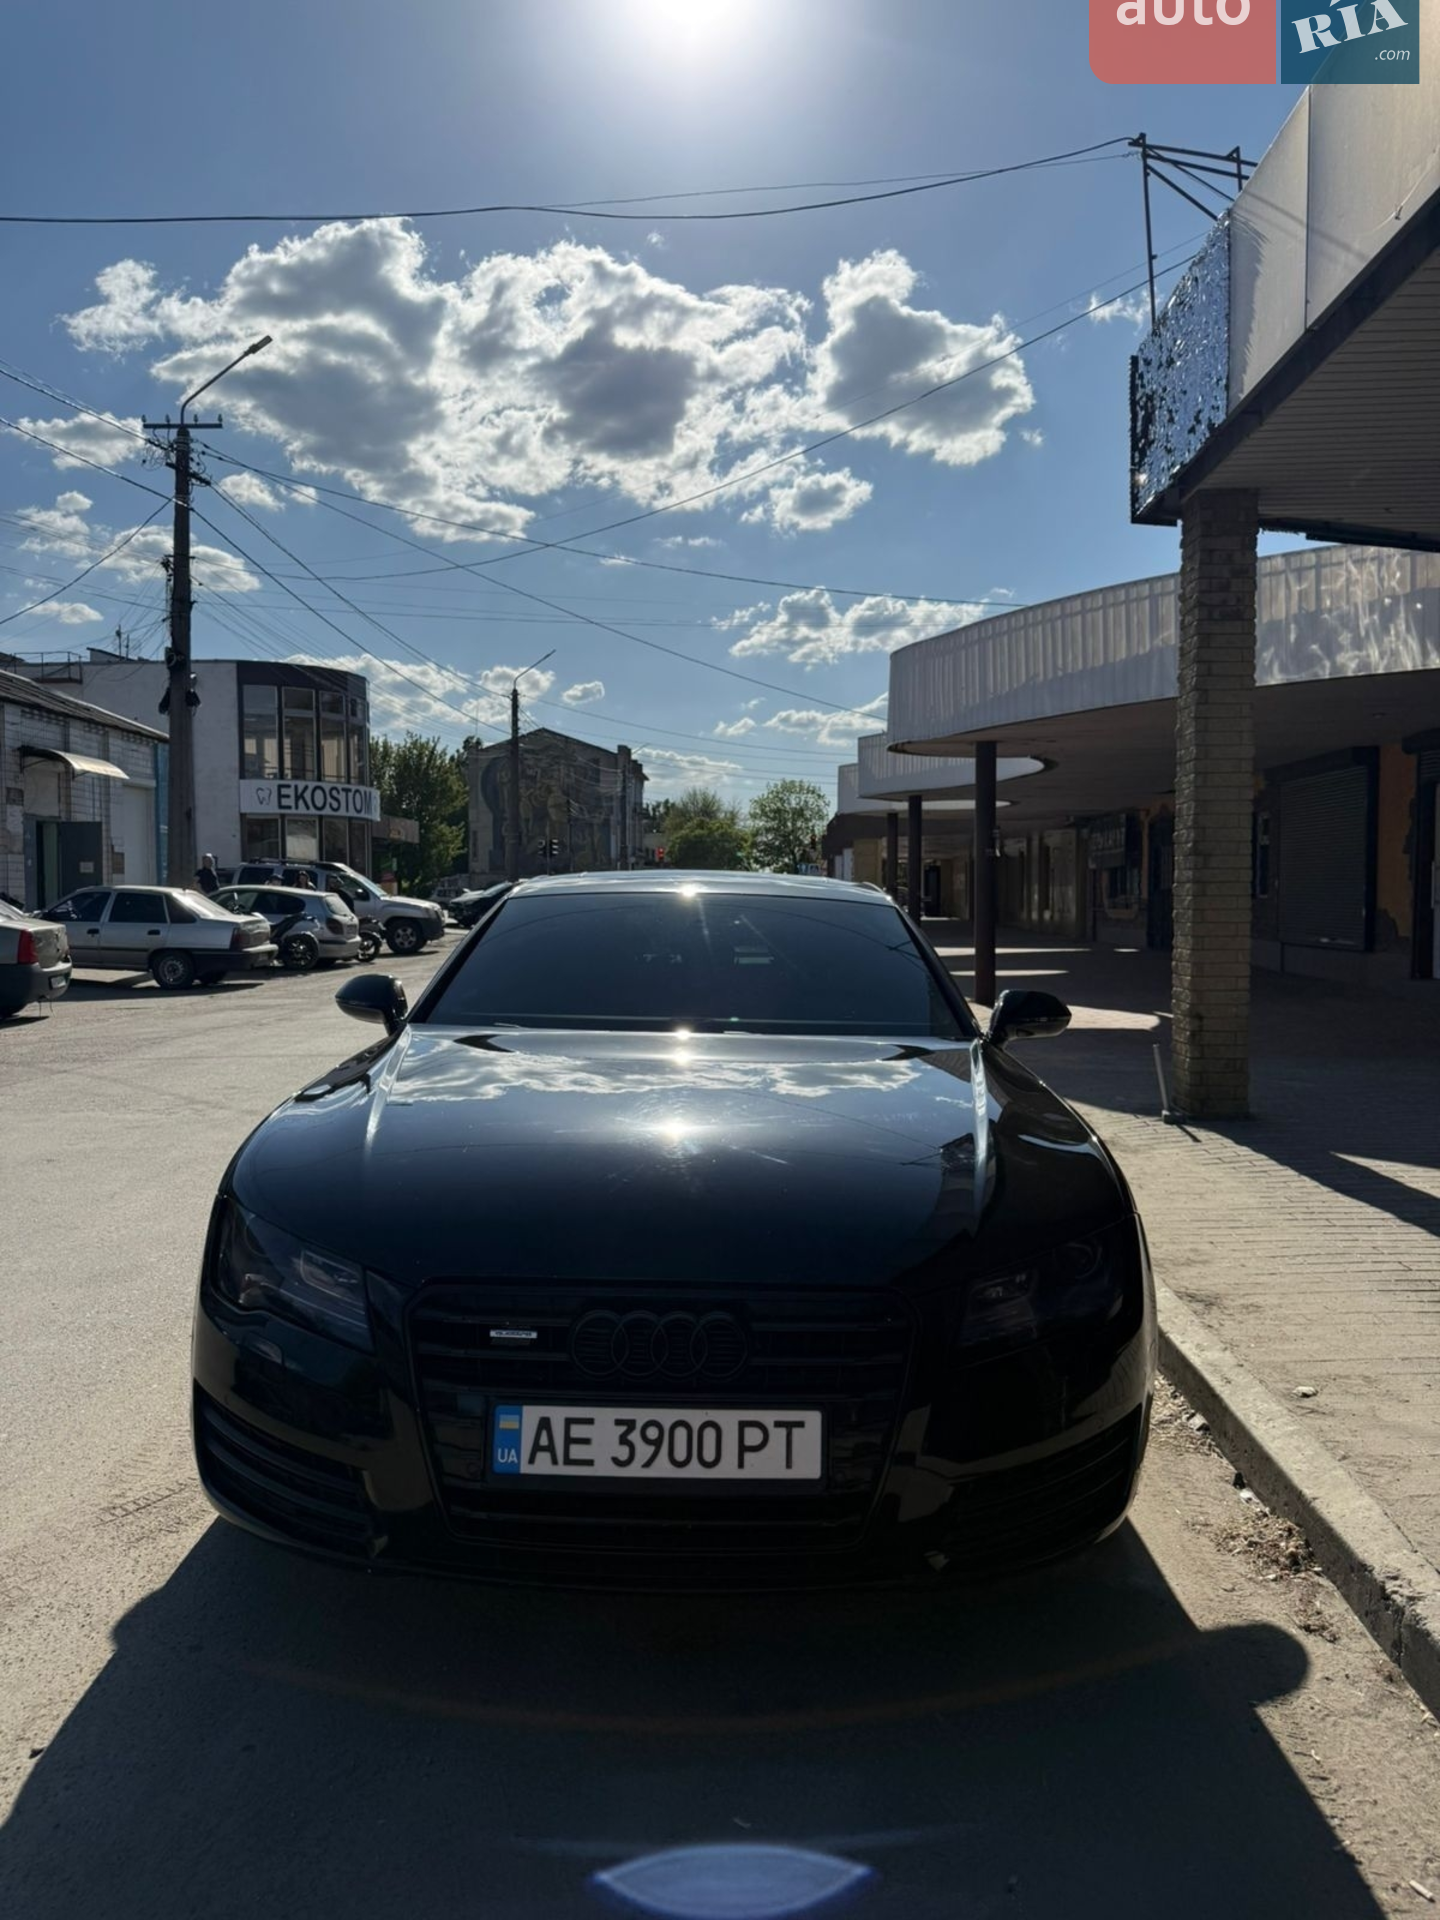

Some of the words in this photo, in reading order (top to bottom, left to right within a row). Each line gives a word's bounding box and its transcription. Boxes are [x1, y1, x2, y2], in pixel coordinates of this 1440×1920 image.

[277, 784, 372, 814] EKOSTOM
[497, 1448, 518, 1464] UA
[528, 1416, 595, 1466] AE
[610, 1418, 723, 1469] 3900
[737, 1420, 805, 1470] PT
